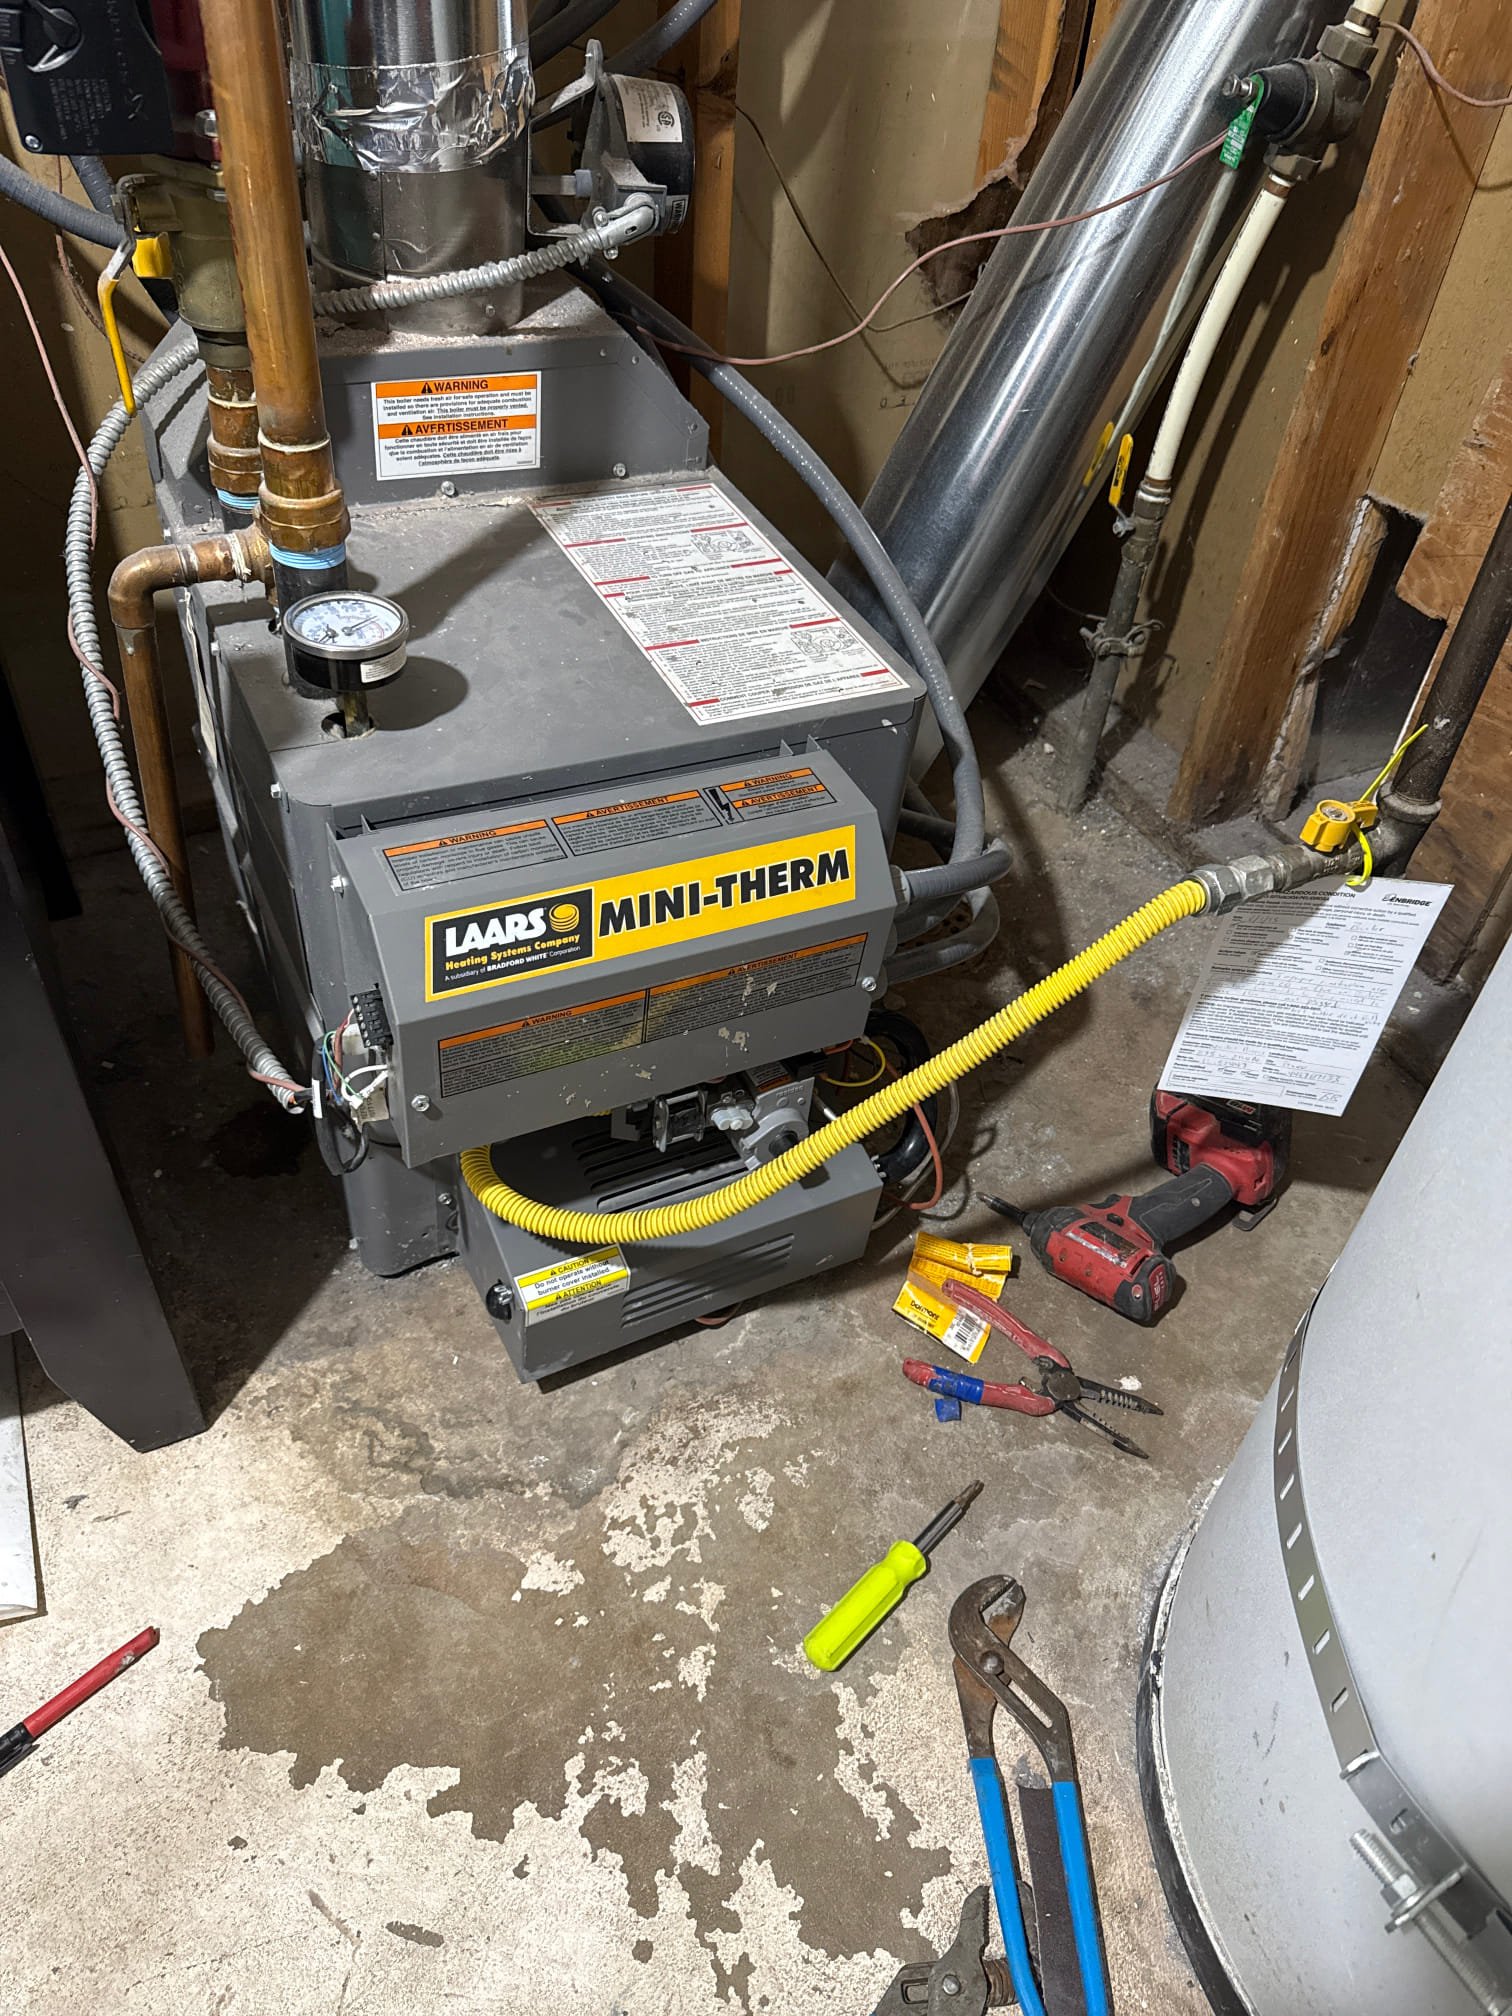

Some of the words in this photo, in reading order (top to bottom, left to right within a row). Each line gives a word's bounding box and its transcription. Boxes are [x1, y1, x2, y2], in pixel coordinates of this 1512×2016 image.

[434, 380, 488, 391] WARNING
[415, 419, 508, 433] AVERTISSEMENT
[752, 773, 792, 784] WARNING
[750, 786, 818, 803] AVERTISSEMENT
[595, 797, 669, 814] AVERTISSEMENT
[449, 830, 497, 843] WARNING
[599, 849, 850, 937] MINI-THERM
[1390, 896, 1432, 906] ENBRIDGE
[445, 907, 546, 957] LAARS
[445, 953, 487, 972] Heating
[491, 943, 531, 961] Systems
[535, 932, 579, 951] Company
[450, 968, 478, 980] subsidiary
[487, 958, 524, 971] BRADFORD
[526, 953, 545, 962] WHITE
[549, 945, 580, 957] Corporation
[532, 1009, 572, 1024] WARNING
[559, 1259, 589, 1272] CAUTION
[559, 1269, 583, 1280] operate
[586, 1260, 609, 1270] without
[538, 1284, 560, 1295] burner
[562, 1278, 580, 1286] cover
[582, 1267, 609, 1279] installed
[563, 1280, 601, 1297] ATTENTION
